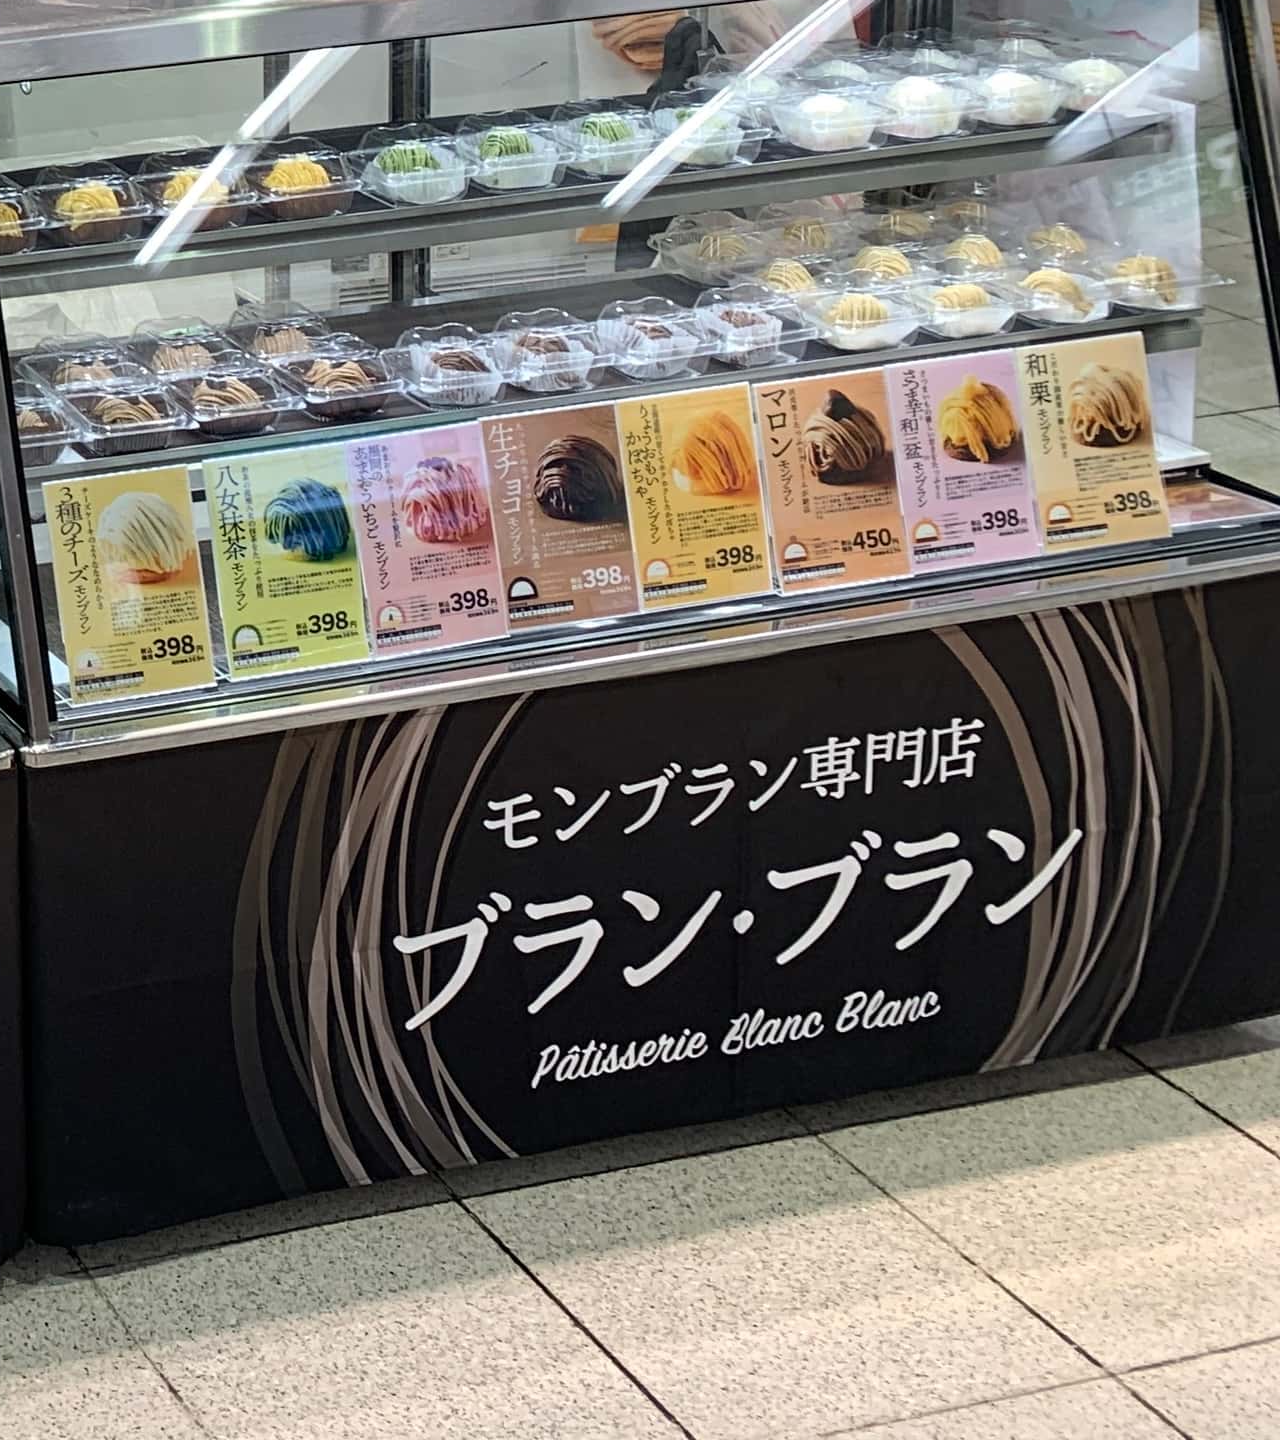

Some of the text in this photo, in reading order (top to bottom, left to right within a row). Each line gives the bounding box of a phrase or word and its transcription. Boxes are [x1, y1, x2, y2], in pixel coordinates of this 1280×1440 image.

[483, 717, 985, 850] モンブラン専門店
[392, 828, 1084, 1031] ブラン・ブラン
[531, 987, 941, 1089] Pâtisserie Blanc Blanc
